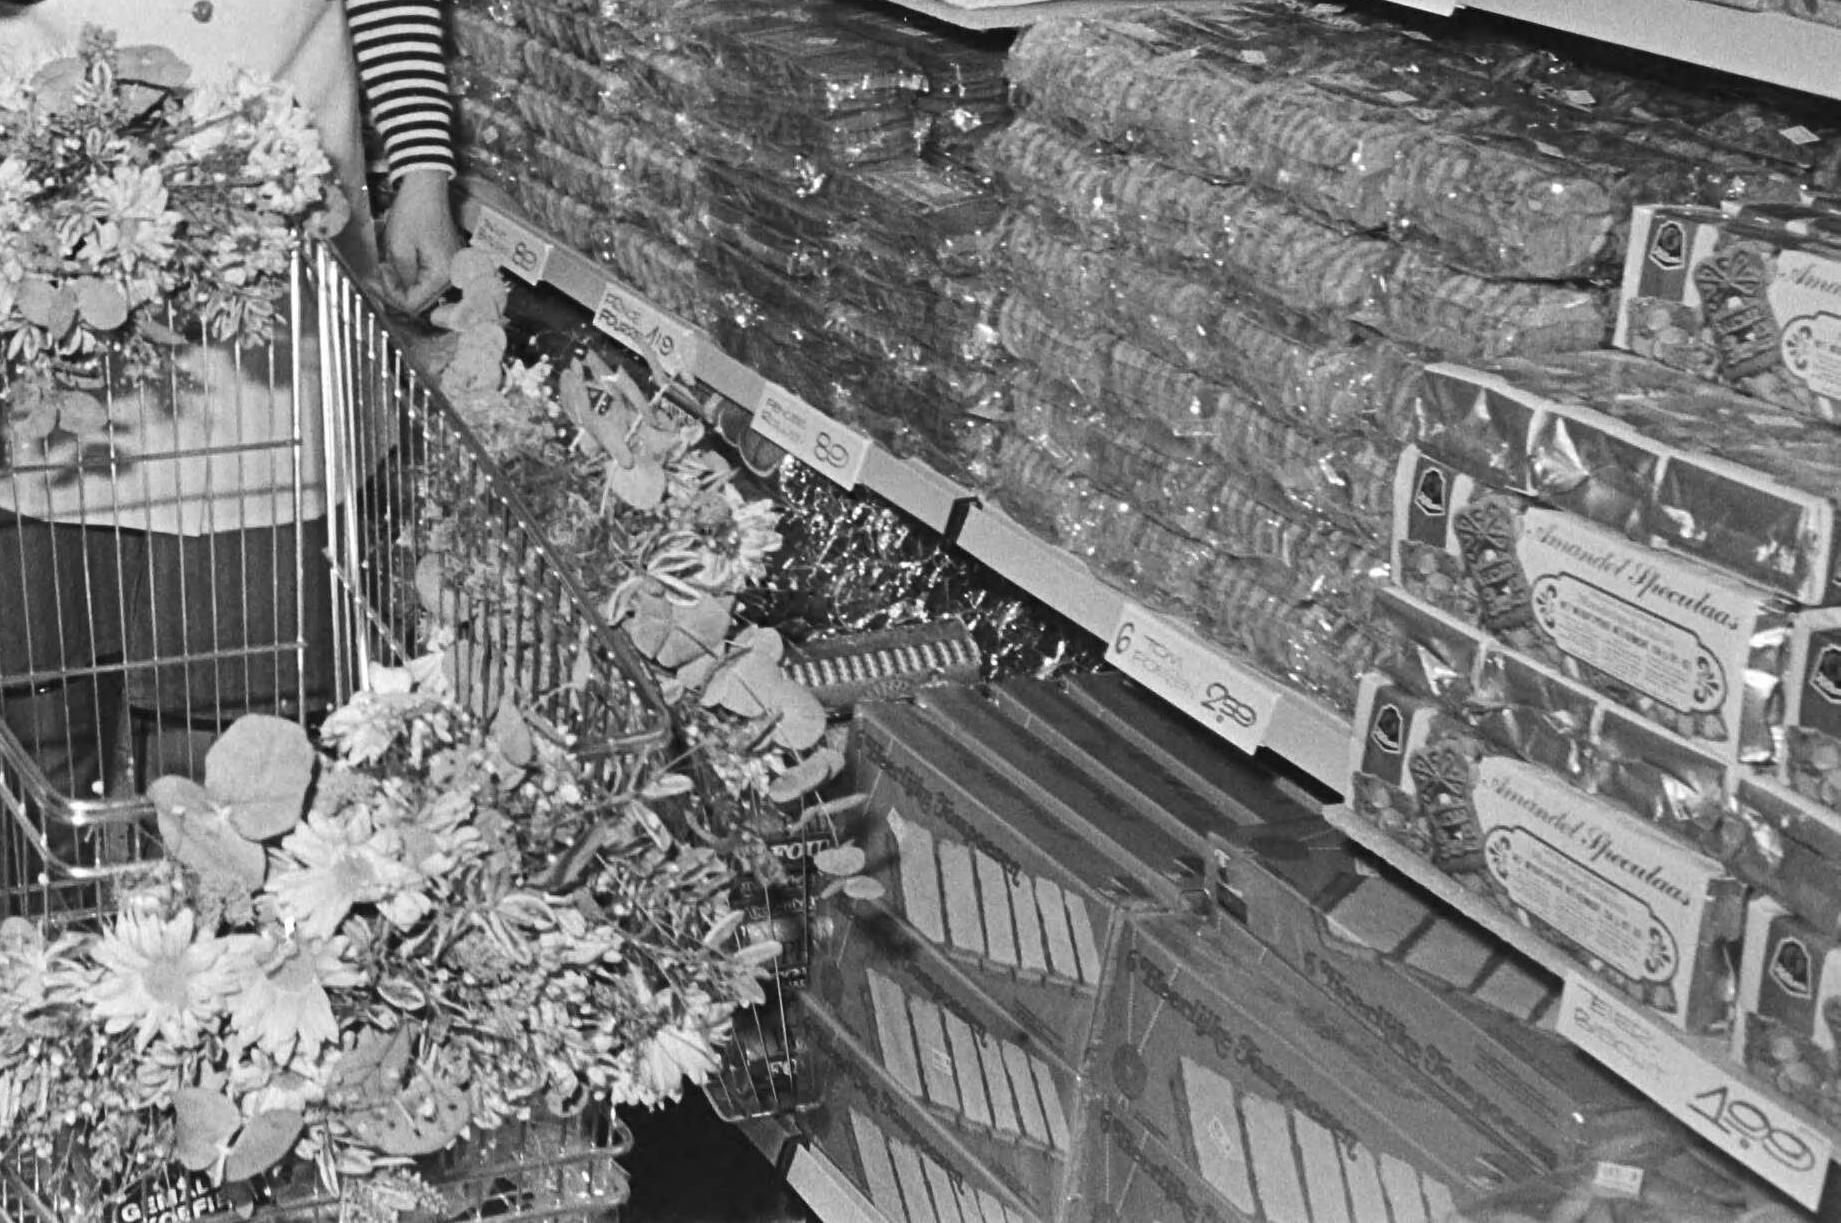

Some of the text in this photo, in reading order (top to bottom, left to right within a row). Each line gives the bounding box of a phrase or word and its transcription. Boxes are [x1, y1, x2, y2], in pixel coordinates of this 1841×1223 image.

[814, 431, 850, 469] 89
[1526, 524, 1739, 632] Amandel Speculaas
[1115, 621, 1136, 655] 6
[1480, 777, 1691, 907] Amandel Speculaas
